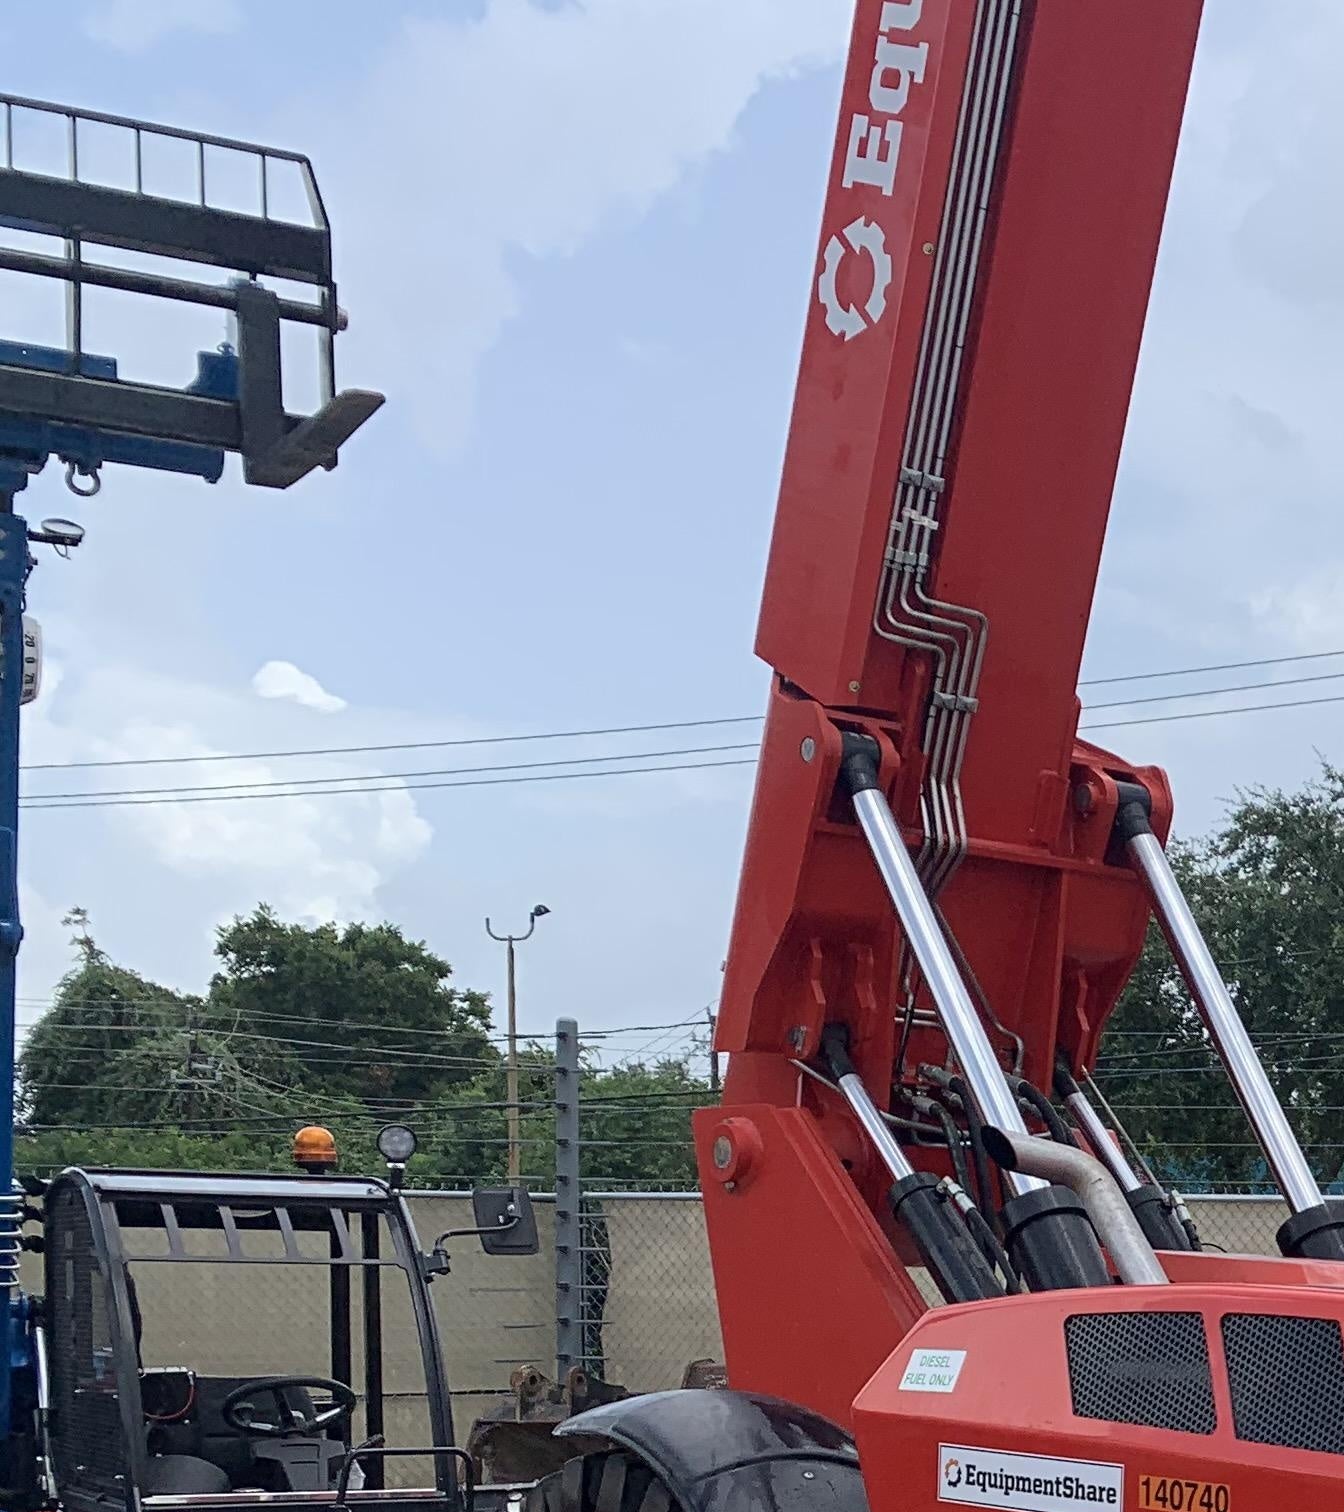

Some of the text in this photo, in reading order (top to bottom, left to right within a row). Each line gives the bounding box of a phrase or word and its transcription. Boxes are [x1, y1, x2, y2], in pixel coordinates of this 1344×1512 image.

[919, 1355, 951, 1368] DIESEL
[904, 1372, 954, 1386] FUEL ONLY
[965, 1463, 1117, 1505] EquipmentShare
